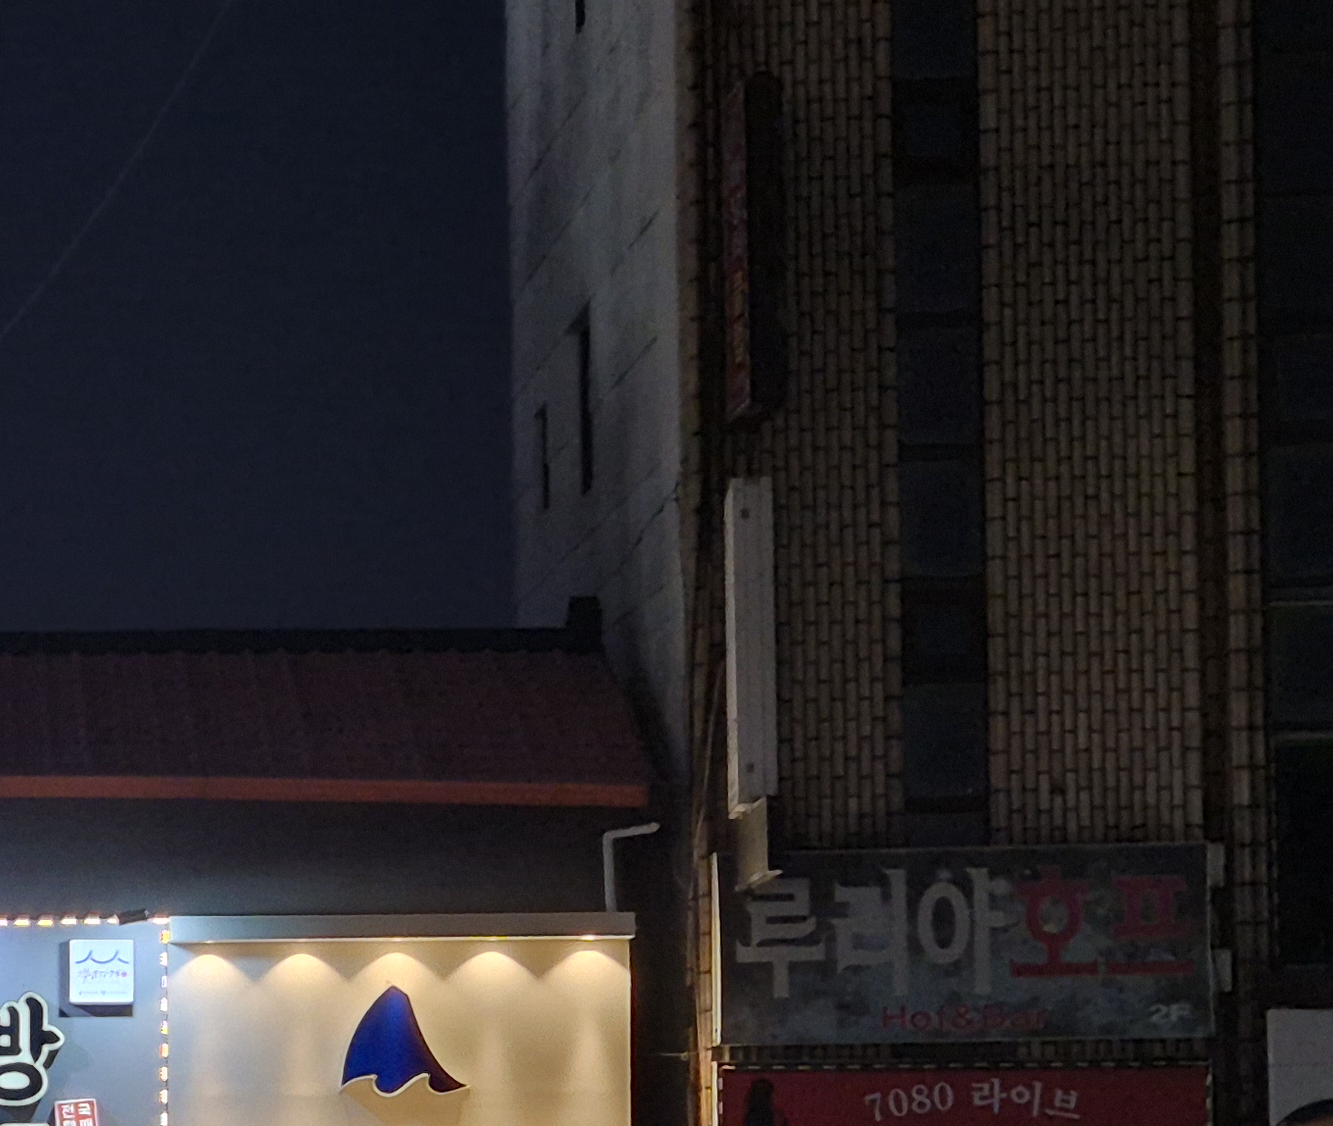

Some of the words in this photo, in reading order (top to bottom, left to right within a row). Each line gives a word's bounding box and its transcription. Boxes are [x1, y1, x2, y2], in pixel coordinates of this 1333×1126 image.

[1148, 1002, 1193, 1023] 2F
[865, 1081, 954, 1122] 7080
[970, 1076, 1082, 1121] 라이브
[61, 1102, 92, 1119] 전국
